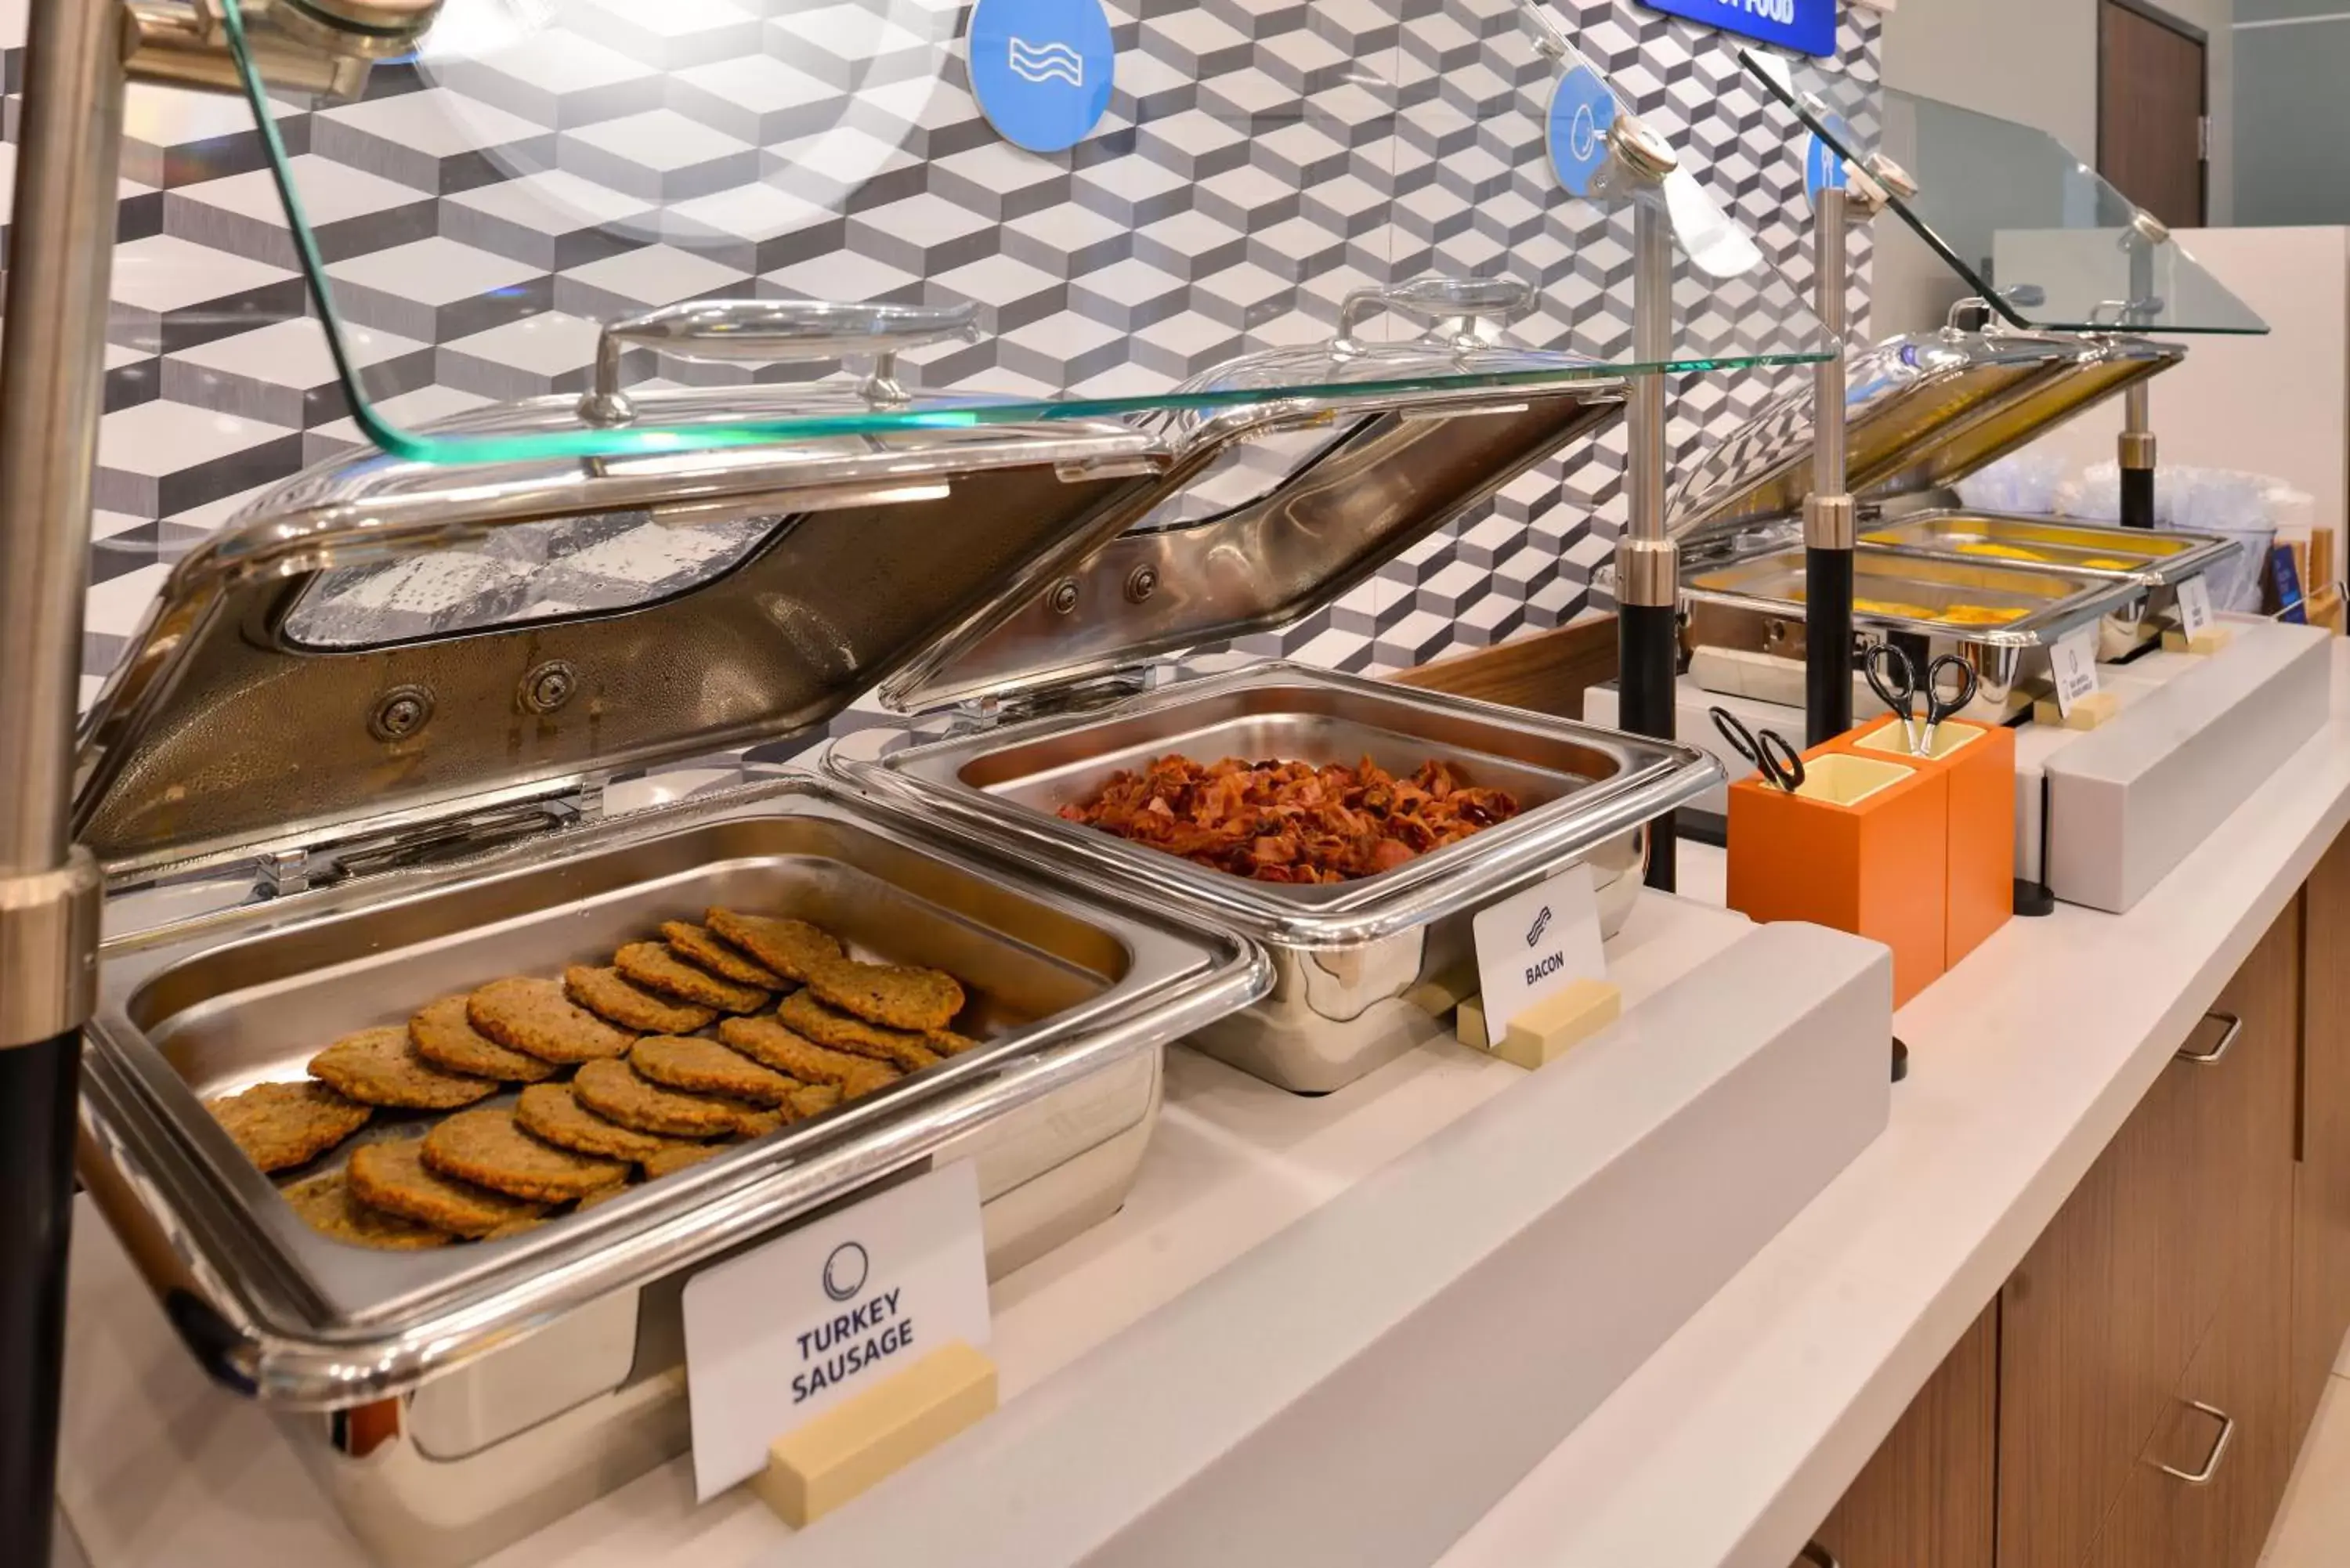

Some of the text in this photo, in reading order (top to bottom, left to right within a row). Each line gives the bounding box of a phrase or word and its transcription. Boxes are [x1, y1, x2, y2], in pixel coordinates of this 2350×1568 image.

[1525, 950, 1564, 986] BACON
[797, 1287, 900, 1360] TURKEY
[791, 1317, 913, 1404] SAUSAGE
